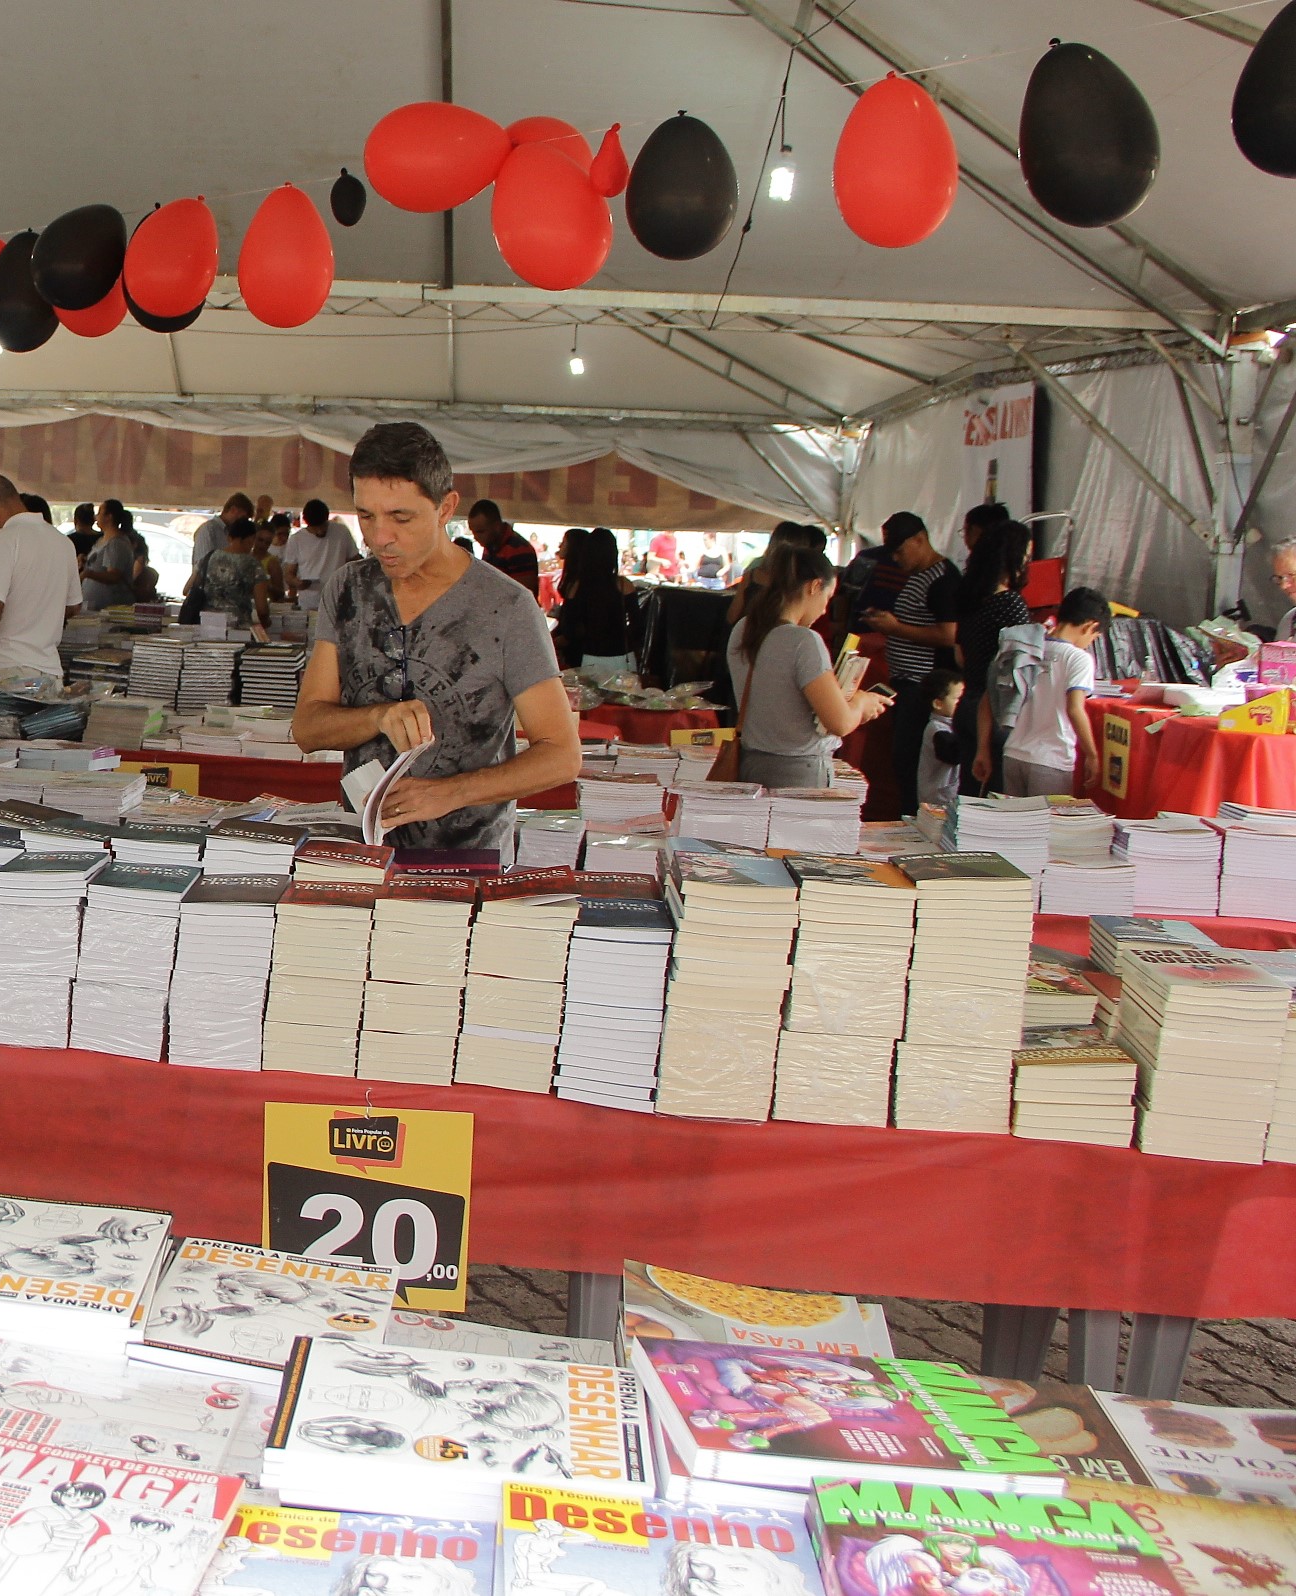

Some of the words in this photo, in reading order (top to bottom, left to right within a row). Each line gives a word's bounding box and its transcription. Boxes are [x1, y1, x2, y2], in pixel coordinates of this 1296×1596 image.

[333, 1127, 395, 1153] Livro
[189, 1239, 265, 1257] APRENDA
[179, 1244, 391, 1290] DESENHAR
[42, 1295, 126, 1314] APRENDA
[731, 1327, 806, 1350] CASA
[618, 1370, 639, 1410] APRENDA
[566, 1364, 621, 1482] DESENHAR
[876, 1432, 900, 1455] APRENDA
[40, 1446, 123, 1468] COMPLETO
[123, 1461, 145, 1473] DE
[145, 1464, 218, 1485] DESENHO
[1078, 1457, 1130, 1476] EM
[509, 1482, 555, 1496] Curso
[559, 1488, 619, 1504] Técnico
[622, 1496, 641, 1506] de
[257, 1510, 314, 1523] Técnico
[317, 1515, 336, 1524] de
[509, 1490, 796, 1554] Desenho
[814, 1476, 1161, 1556] MANGA
[837, 1507, 851, 1517] O
[857, 1508, 917, 1523] LIVRO
[924, 1513, 1021, 1533] MONSTRO
[1028, 1524, 1059, 1536] DO
